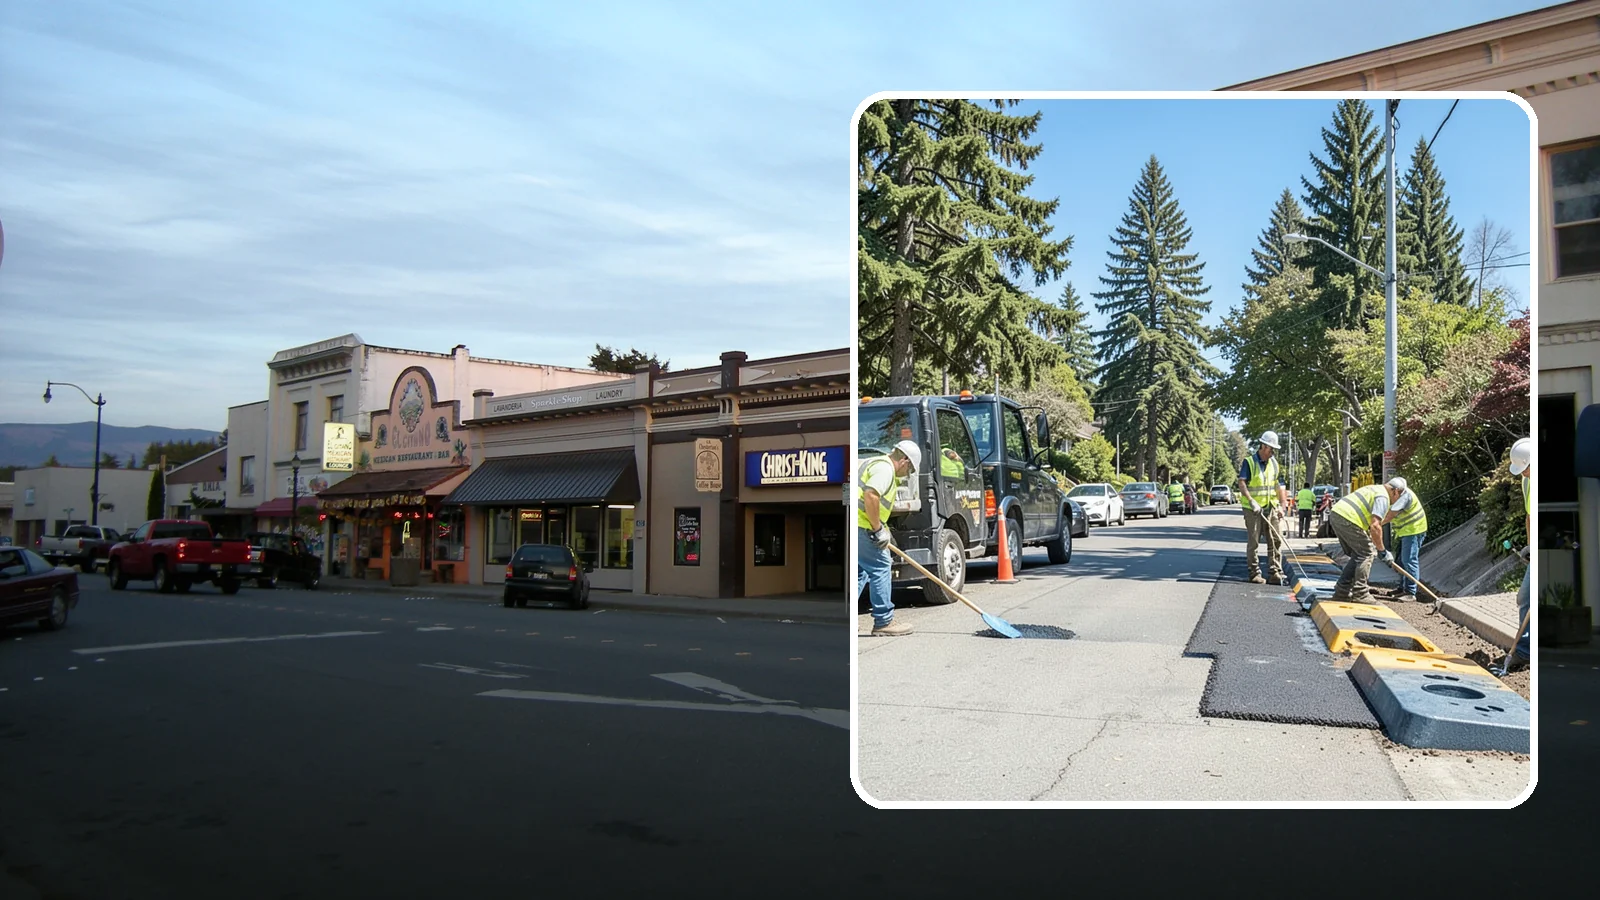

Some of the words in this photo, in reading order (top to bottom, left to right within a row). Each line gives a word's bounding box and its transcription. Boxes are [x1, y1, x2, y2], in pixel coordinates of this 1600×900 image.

[595, 389, 623, 400] LAUNDRY
[493, 402, 522, 412] LAVANDERIA
[531, 397, 560, 409] Sparkle
[562, 394, 583, 404] Shop
[373, 455, 396, 464] MEXICAN
[398, 451, 433, 462] RESTAURANT
[438, 450, 450, 459] BAR
